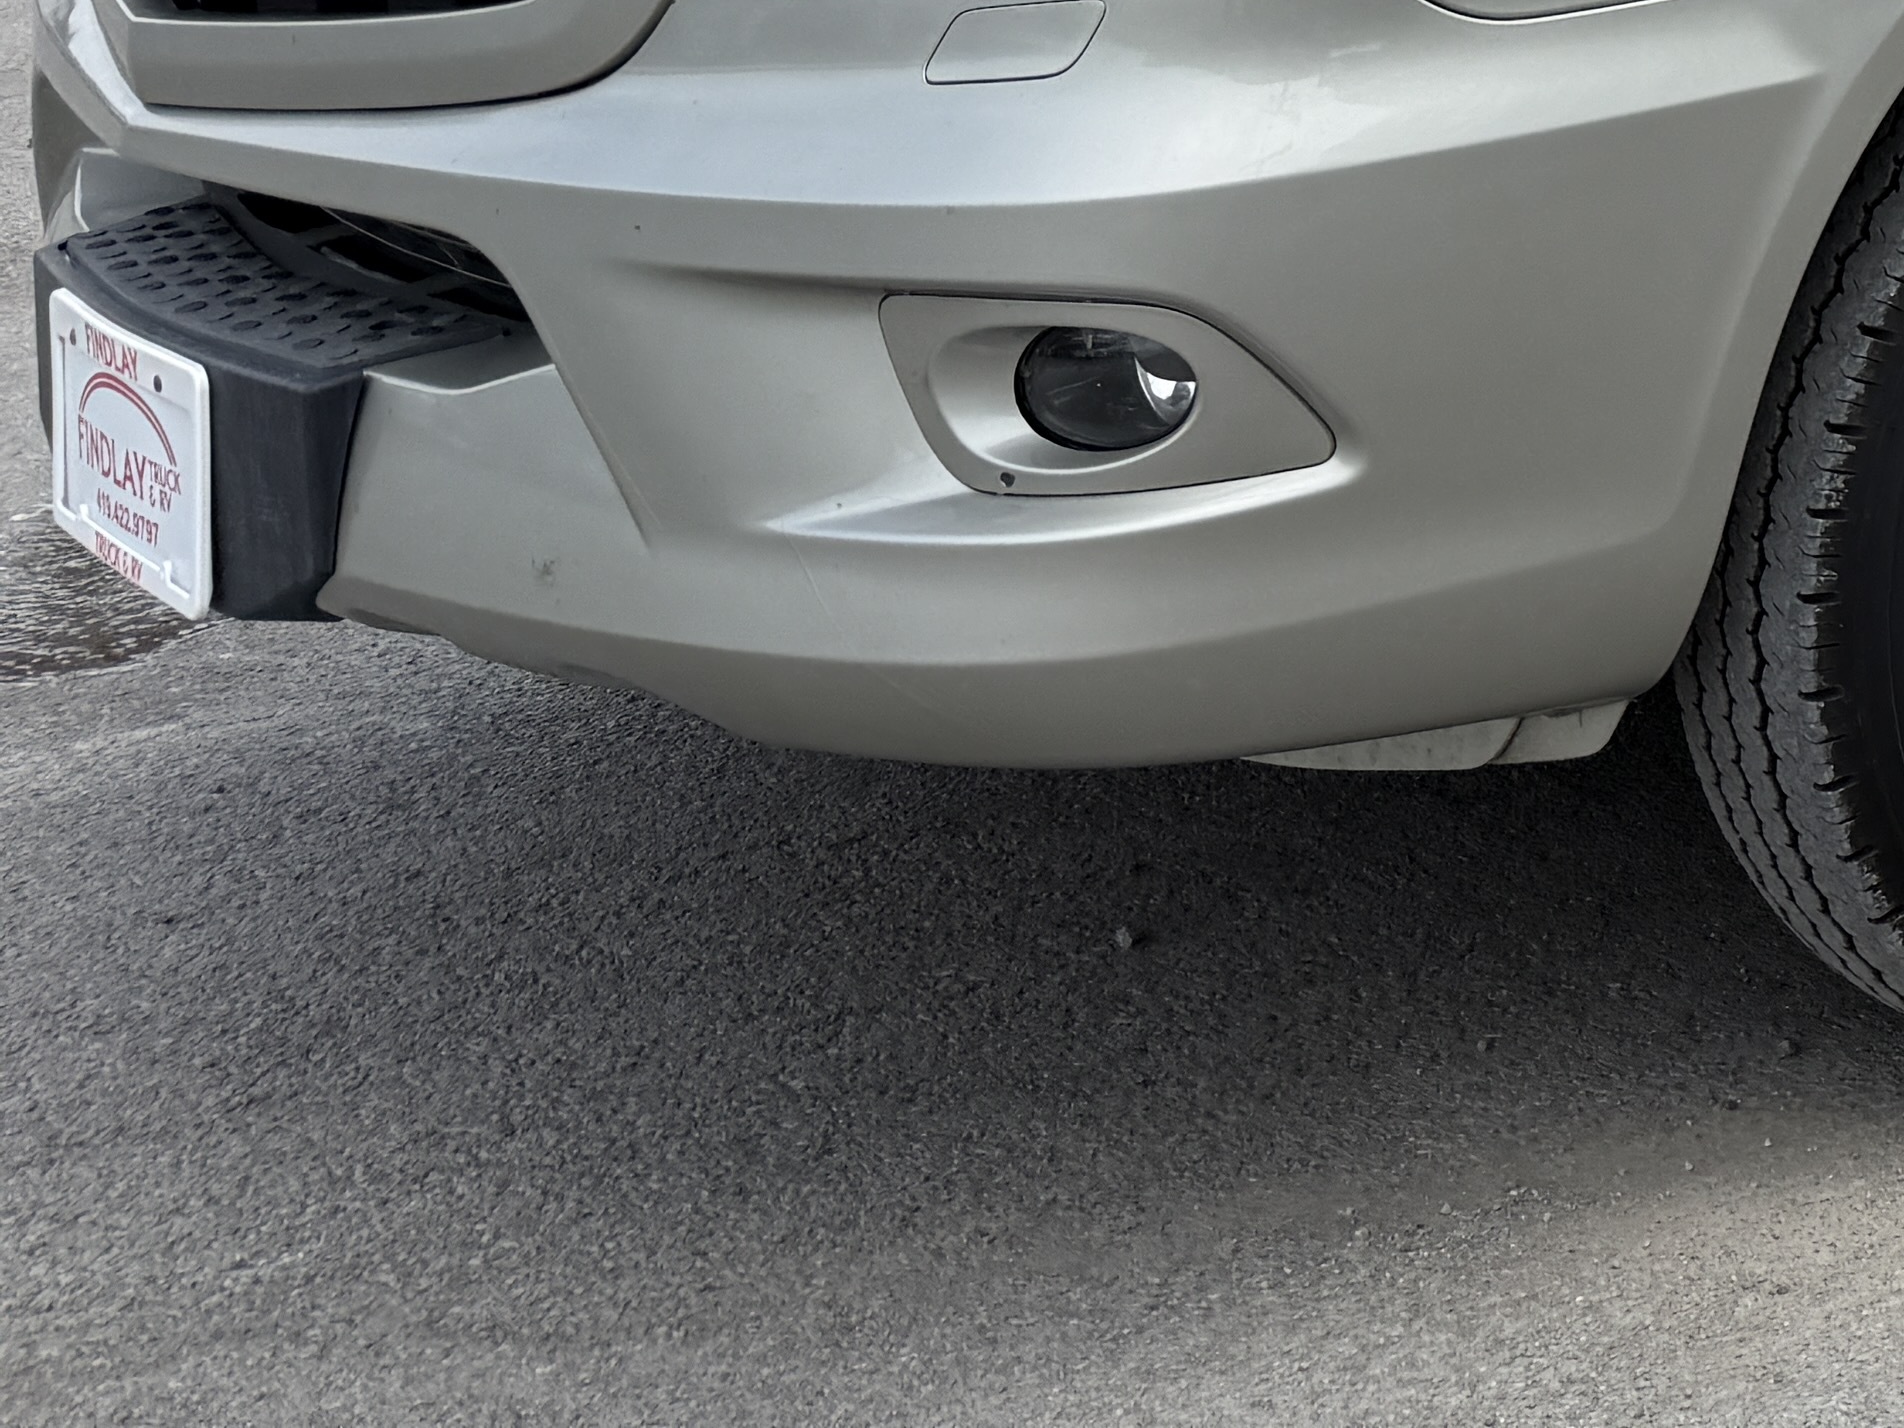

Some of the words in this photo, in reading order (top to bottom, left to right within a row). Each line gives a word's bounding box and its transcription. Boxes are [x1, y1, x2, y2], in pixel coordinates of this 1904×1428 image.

[85, 322, 138, 382] FINDLAY
[78, 413, 146, 500] FINDLAY
[147, 459, 181, 495] TRUCK
[159, 489, 172, 513] RV
[95, 530, 119, 570] TRUCK
